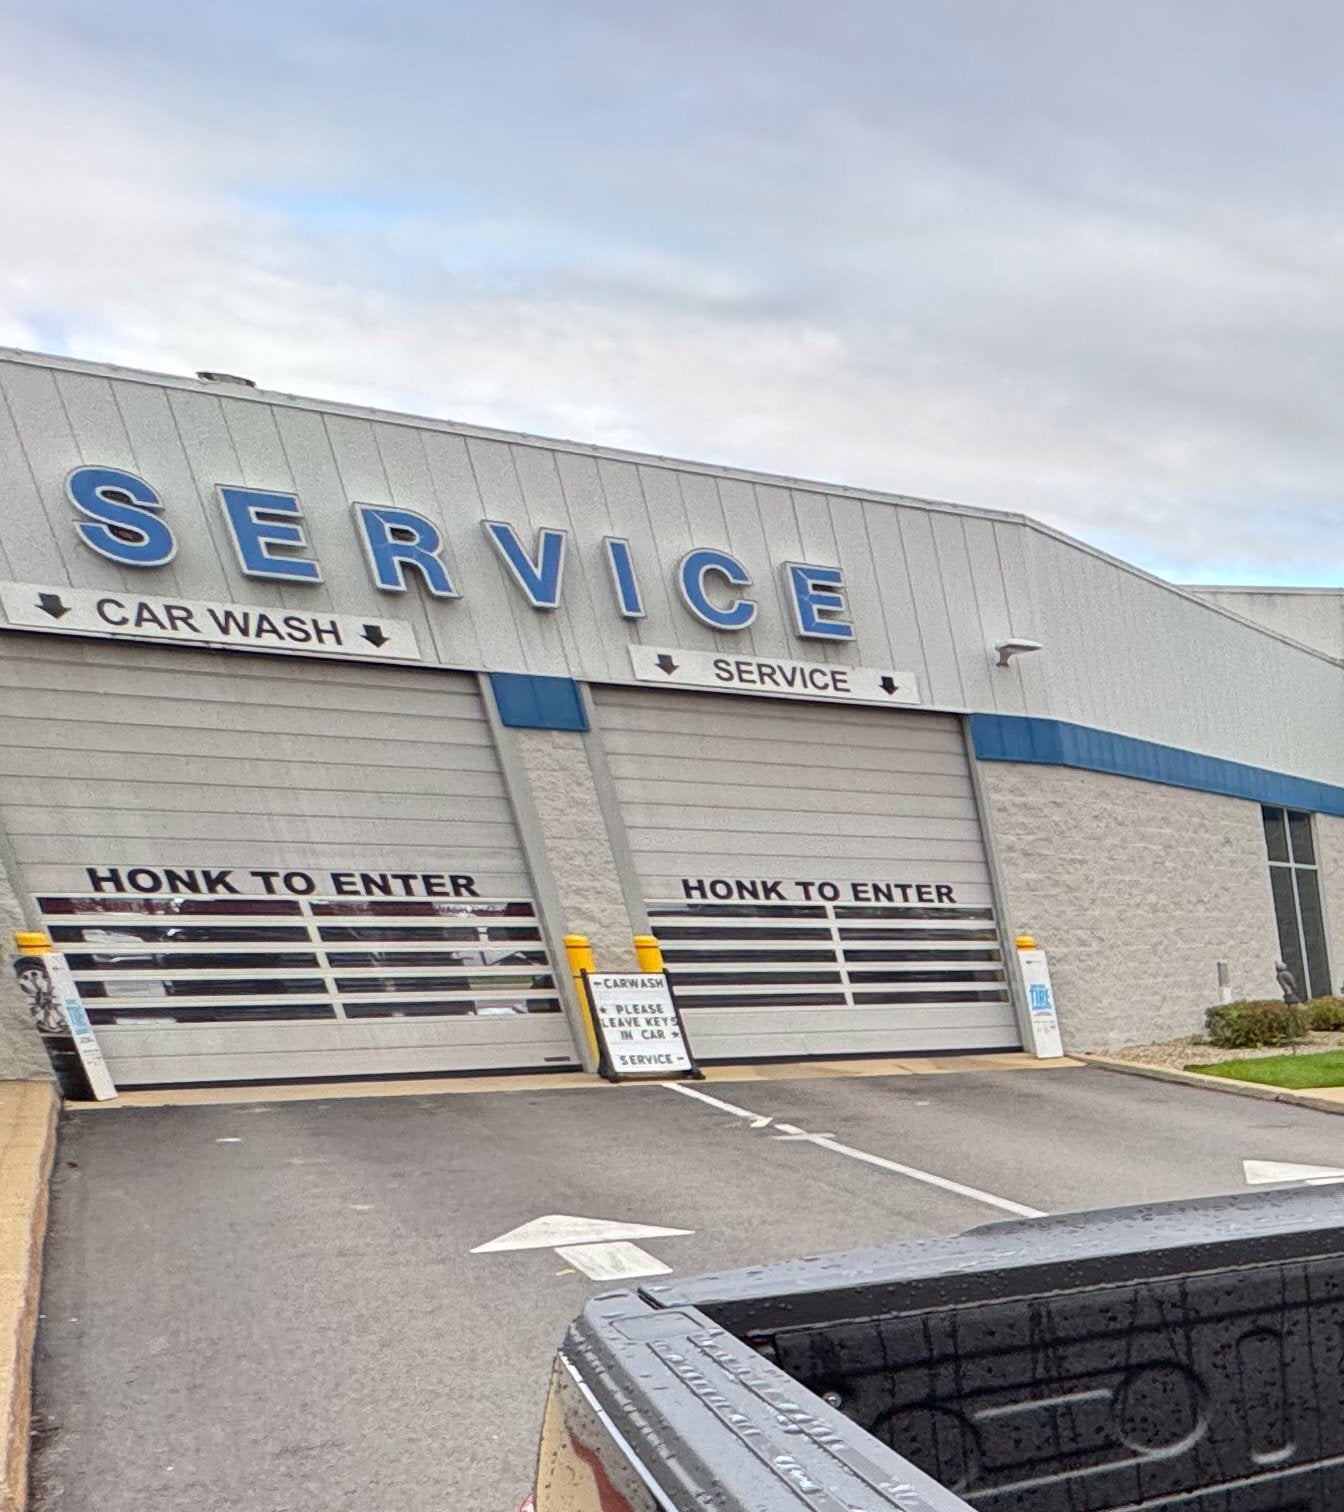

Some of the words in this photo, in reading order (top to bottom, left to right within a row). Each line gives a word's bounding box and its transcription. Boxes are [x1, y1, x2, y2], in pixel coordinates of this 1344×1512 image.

[64, 464, 857, 641] SERVICE
[96, 597, 204, 633] CAR
[207, 608, 343, 645] WASH
[713, 658, 851, 692] SERVICE
[86, 867, 243, 894] HONK
[250, 871, 316, 896] TO
[329, 872, 481, 898] ENTER
[681, 878, 785, 901] HONK
[795, 880, 840, 902] TO
[850, 882, 957, 904] ENTER
[603, 978, 664, 989] CARWASH
[615, 1003, 664, 1014] PLEASE
[601, 1016, 640, 1028] LEAVE
[645, 1016, 678, 1027] KEYS
[620, 1030, 633, 1040] IN
[641, 1029, 666, 1040] CAR
[619, 1053, 674, 1065] SERVICE
